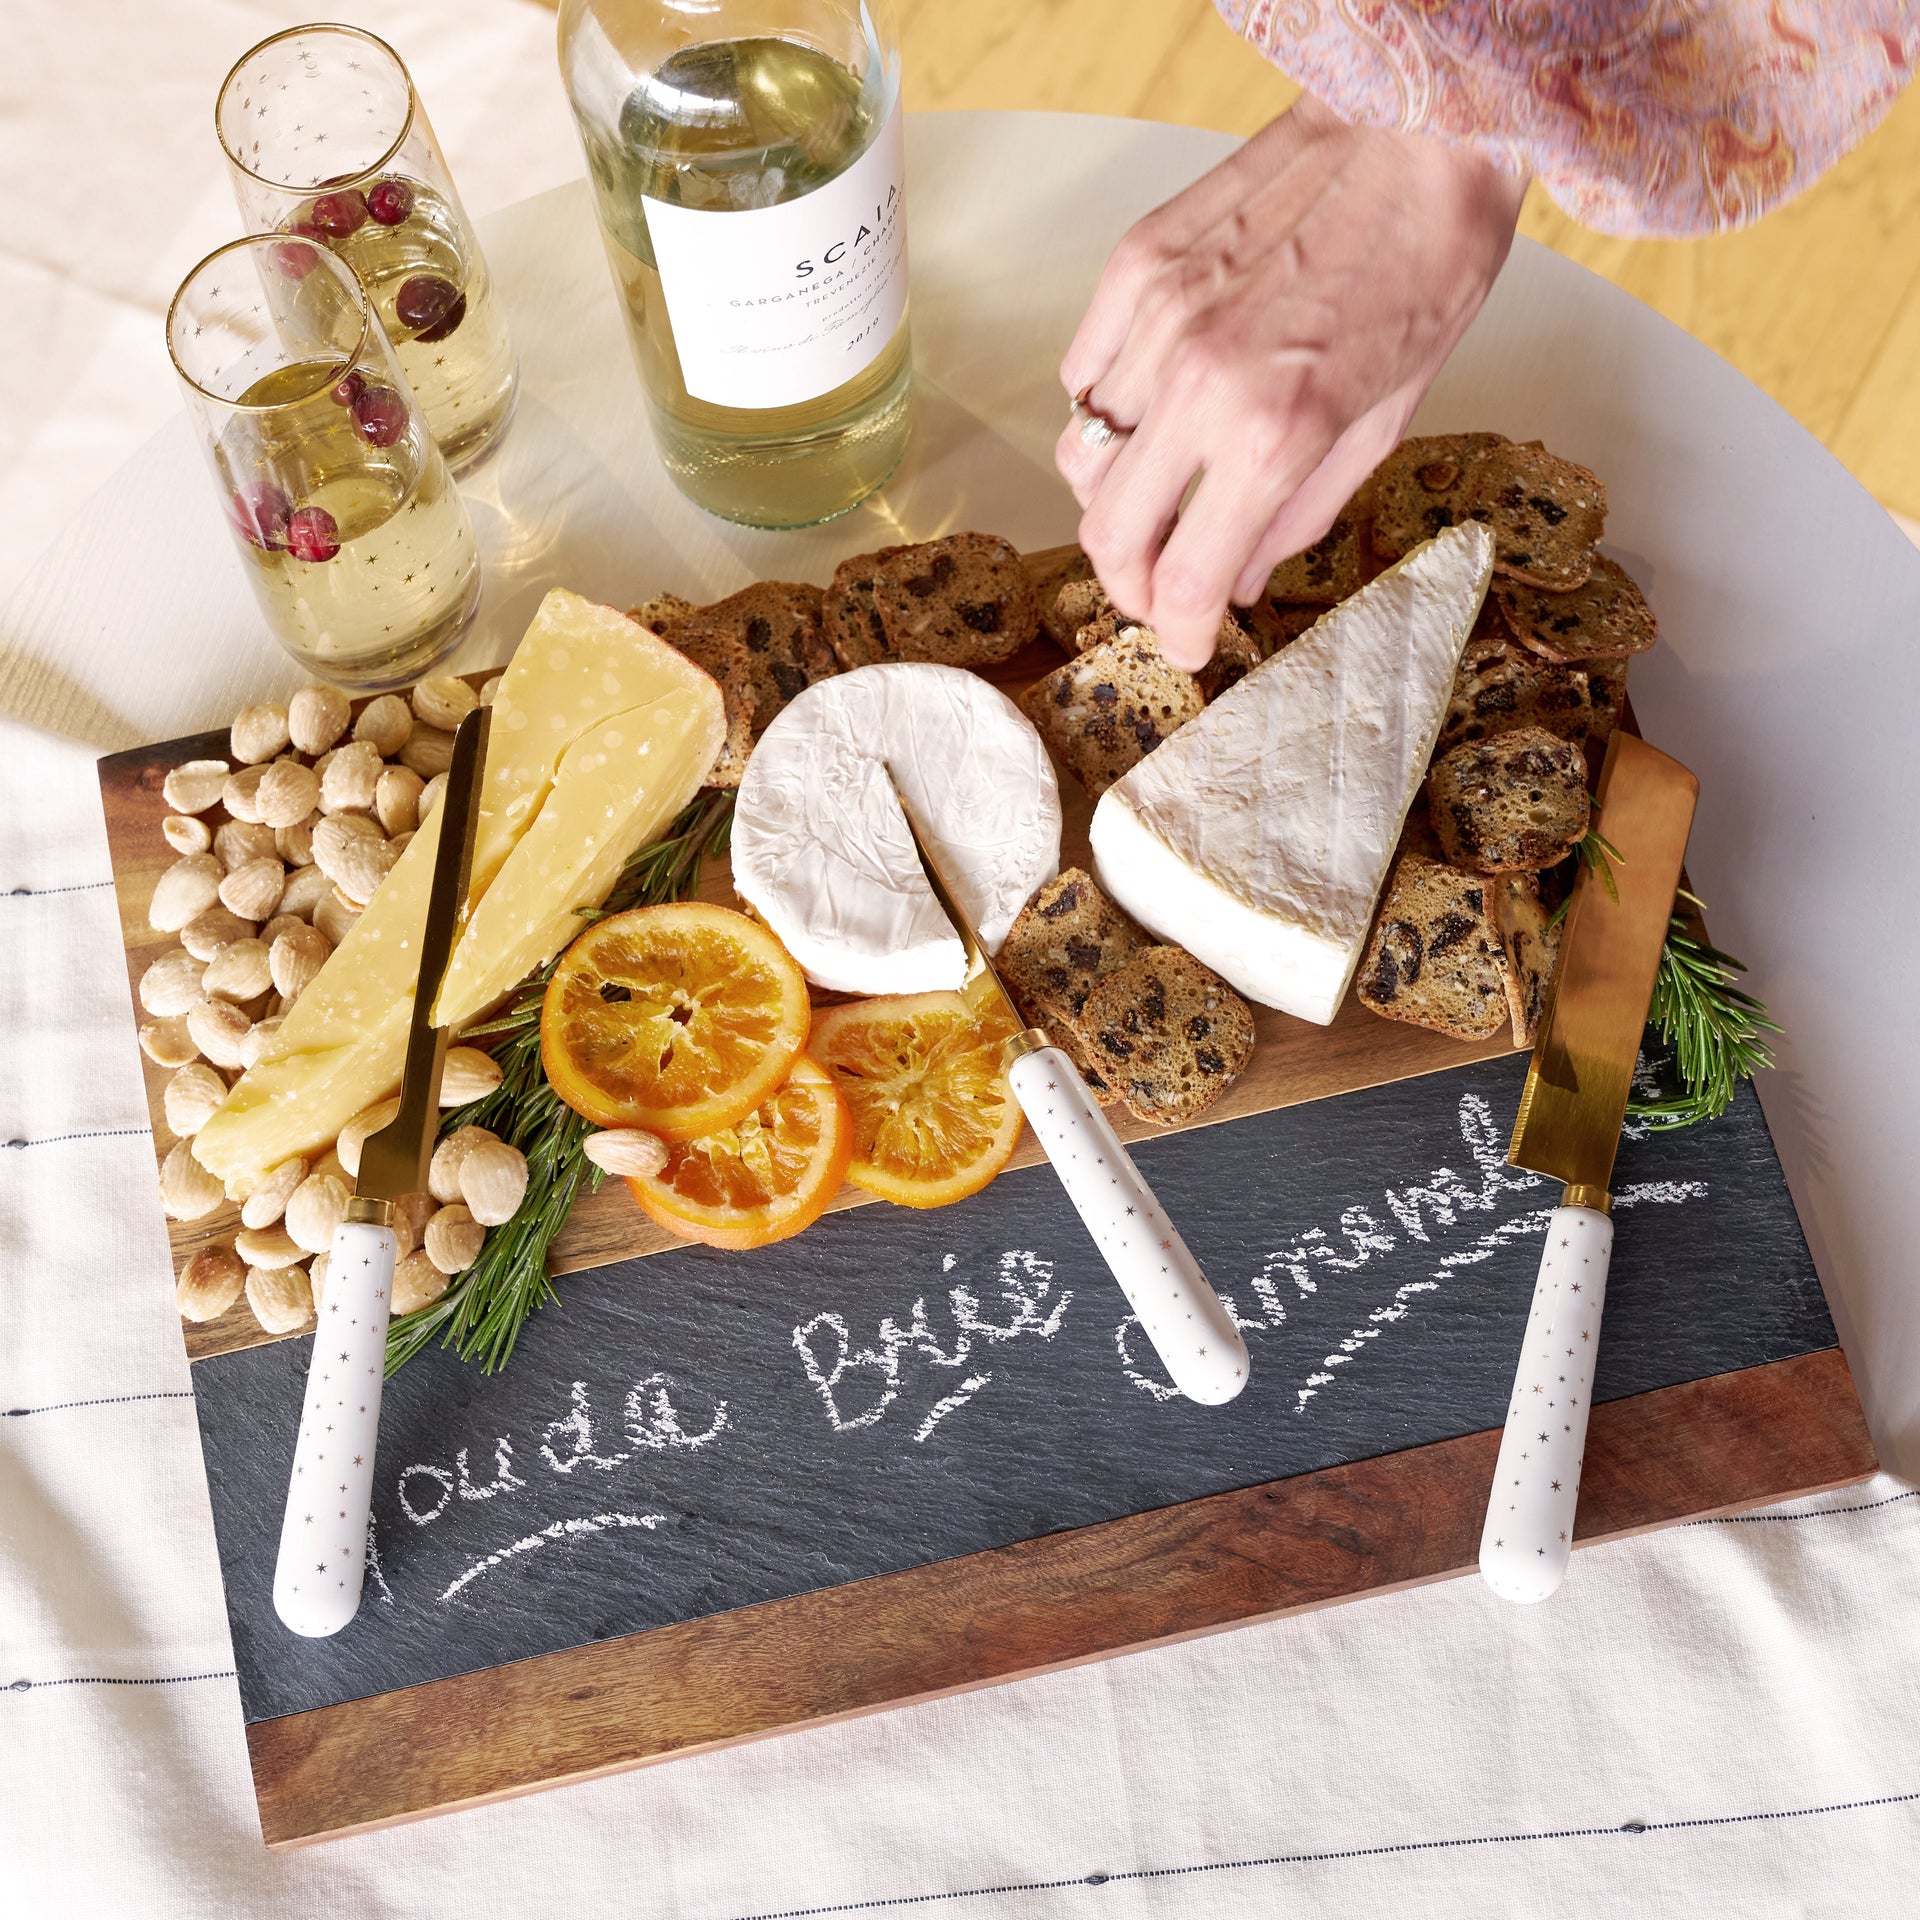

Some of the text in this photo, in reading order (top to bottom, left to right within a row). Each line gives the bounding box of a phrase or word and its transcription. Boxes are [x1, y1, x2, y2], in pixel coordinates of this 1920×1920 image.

[796, 184, 896, 278] SCAIA
[730, 269, 844, 307] GARGANEGA
[806, 256, 877, 308] TREVENEZIE
[364, 1370, 730, 1605] ouda
[792, 1250, 1075, 1431] Brie
